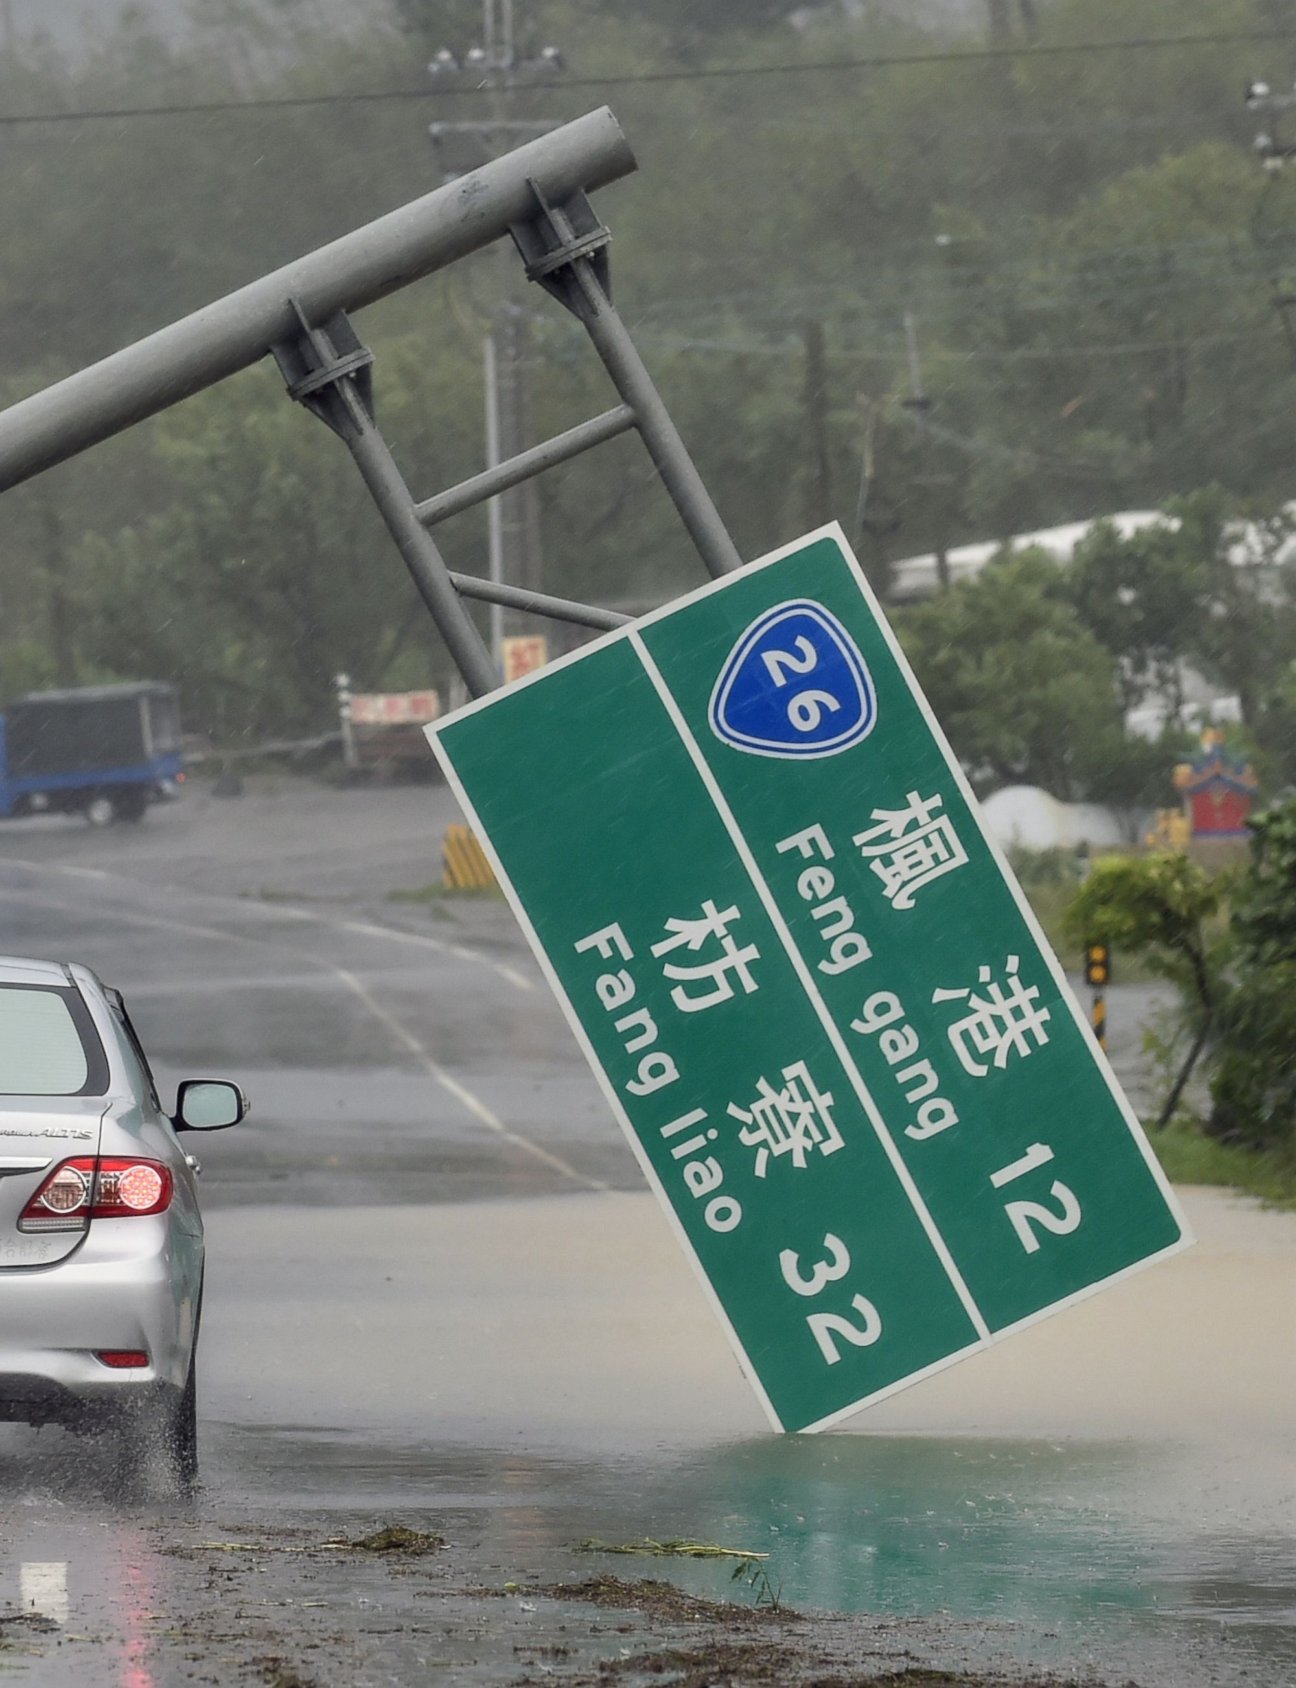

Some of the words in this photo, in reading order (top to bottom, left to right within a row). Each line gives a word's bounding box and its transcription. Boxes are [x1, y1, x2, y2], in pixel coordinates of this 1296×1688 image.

[762, 636, 840, 731] 26
[575, 922, 680, 1096] Fang
[661, 1108, 742, 1233] liao
[651, 900, 846, 1178] 枋寮
[780, 1233, 882, 1365] 32
[776, 823, 873, 975] Feng
[851, 991, 959, 1141] gang
[853, 791, 1051, 1077] 楓港
[990, 1143, 1082, 1253] 12
